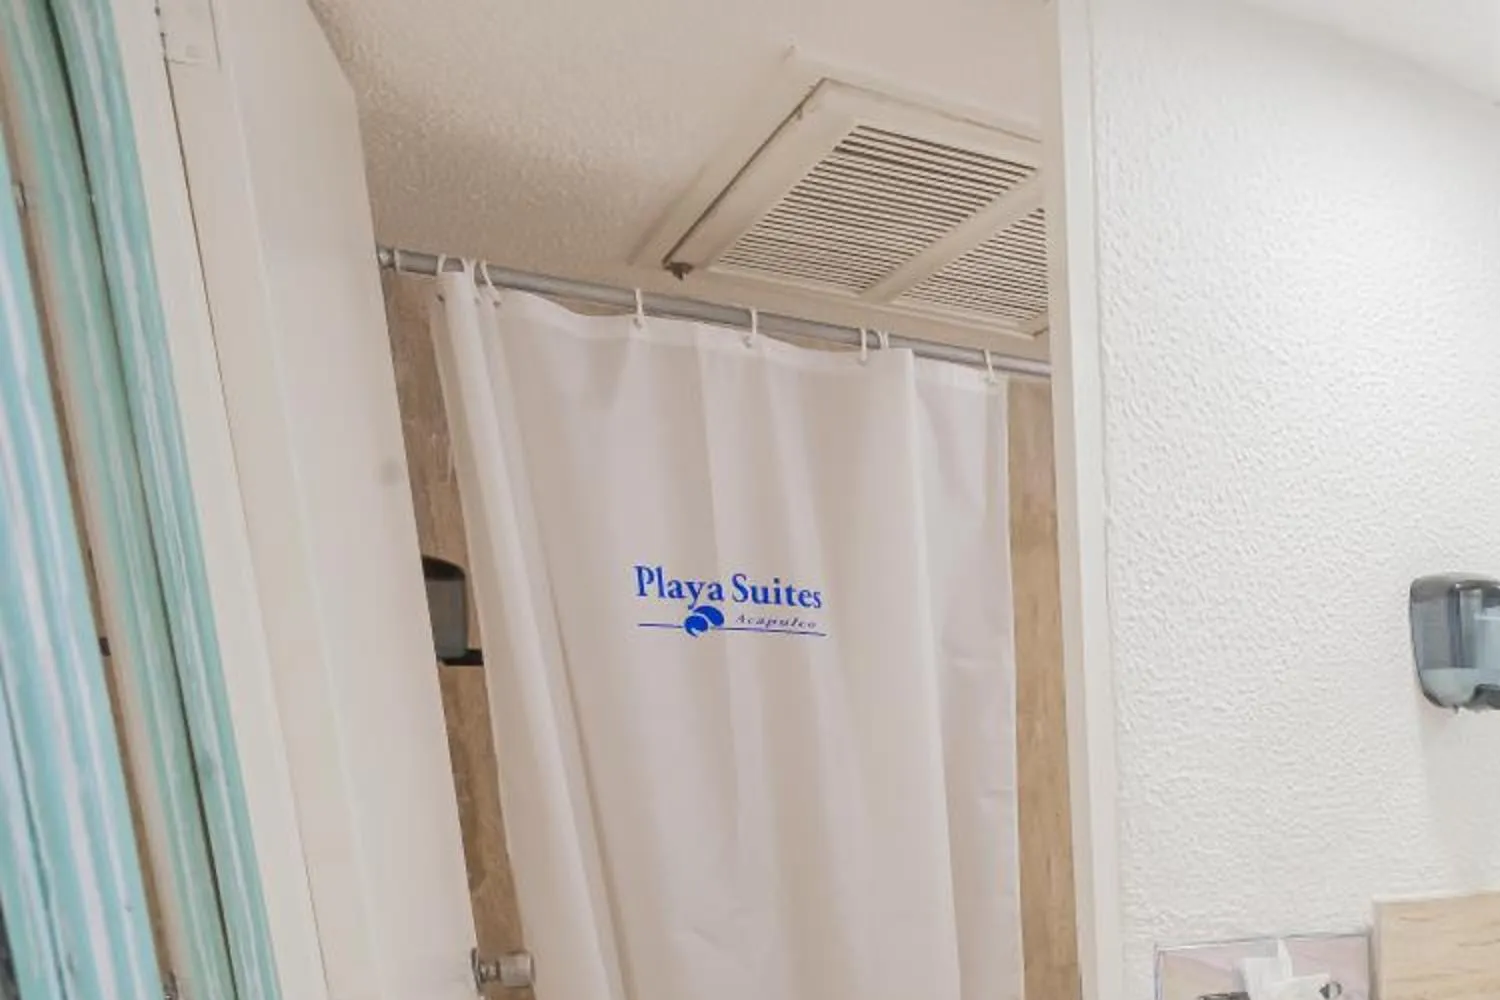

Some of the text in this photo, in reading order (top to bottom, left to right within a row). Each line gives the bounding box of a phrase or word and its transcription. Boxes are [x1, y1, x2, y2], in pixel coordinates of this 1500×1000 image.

[634, 565, 822, 610] Playa Suites
[735, 614, 817, 628] Acapulco
